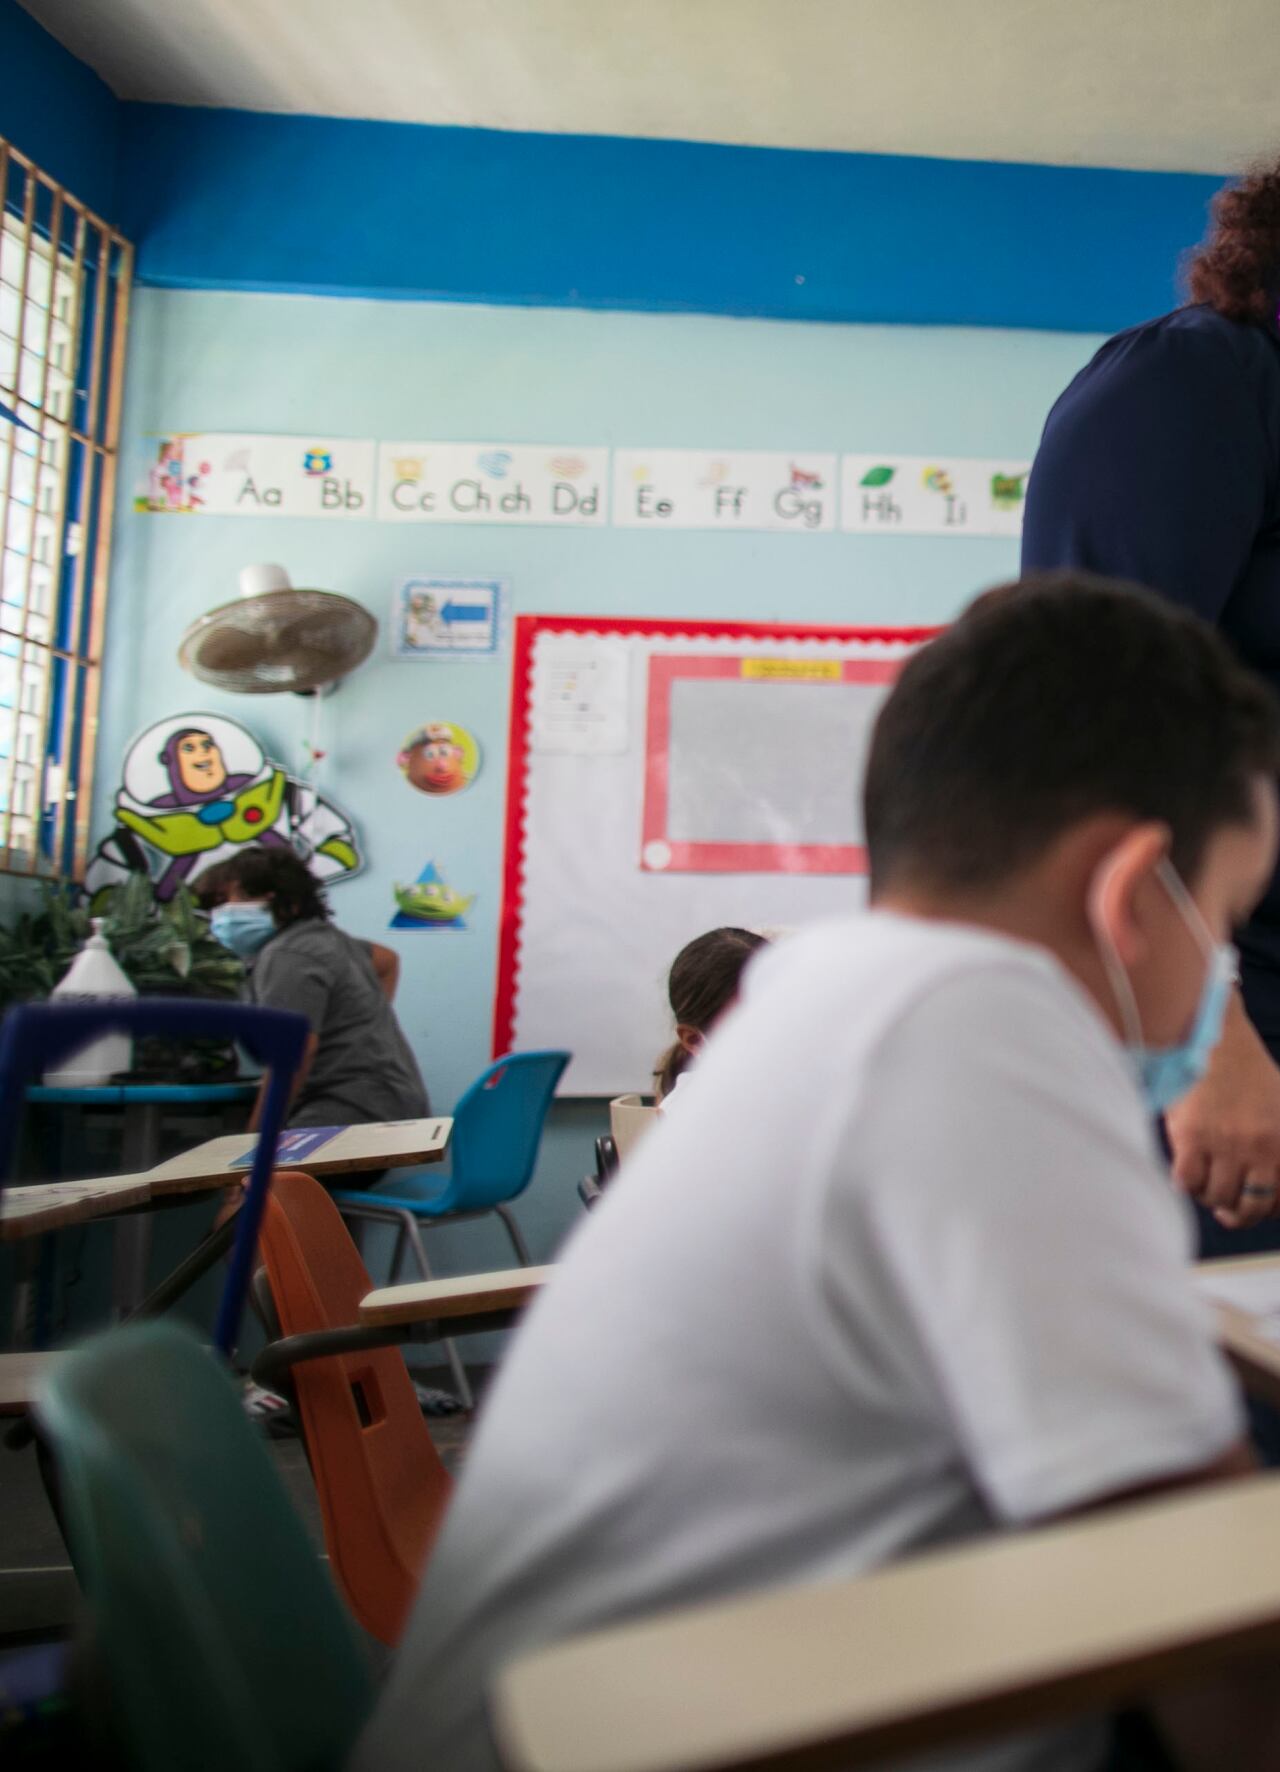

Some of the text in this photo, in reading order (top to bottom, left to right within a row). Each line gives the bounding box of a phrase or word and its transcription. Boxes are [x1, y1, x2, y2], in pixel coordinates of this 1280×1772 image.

[237, 477, 282, 507] Aa
[321, 477, 365, 510] Bb
[391, 479, 435, 512] Cc
[552, 482, 599, 515] Dd
[637, 485, 674, 518] Ee
[715, 487, 747, 518] Ff
[775, 487, 823, 527] Gg
[862, 494, 901, 523] Hh
